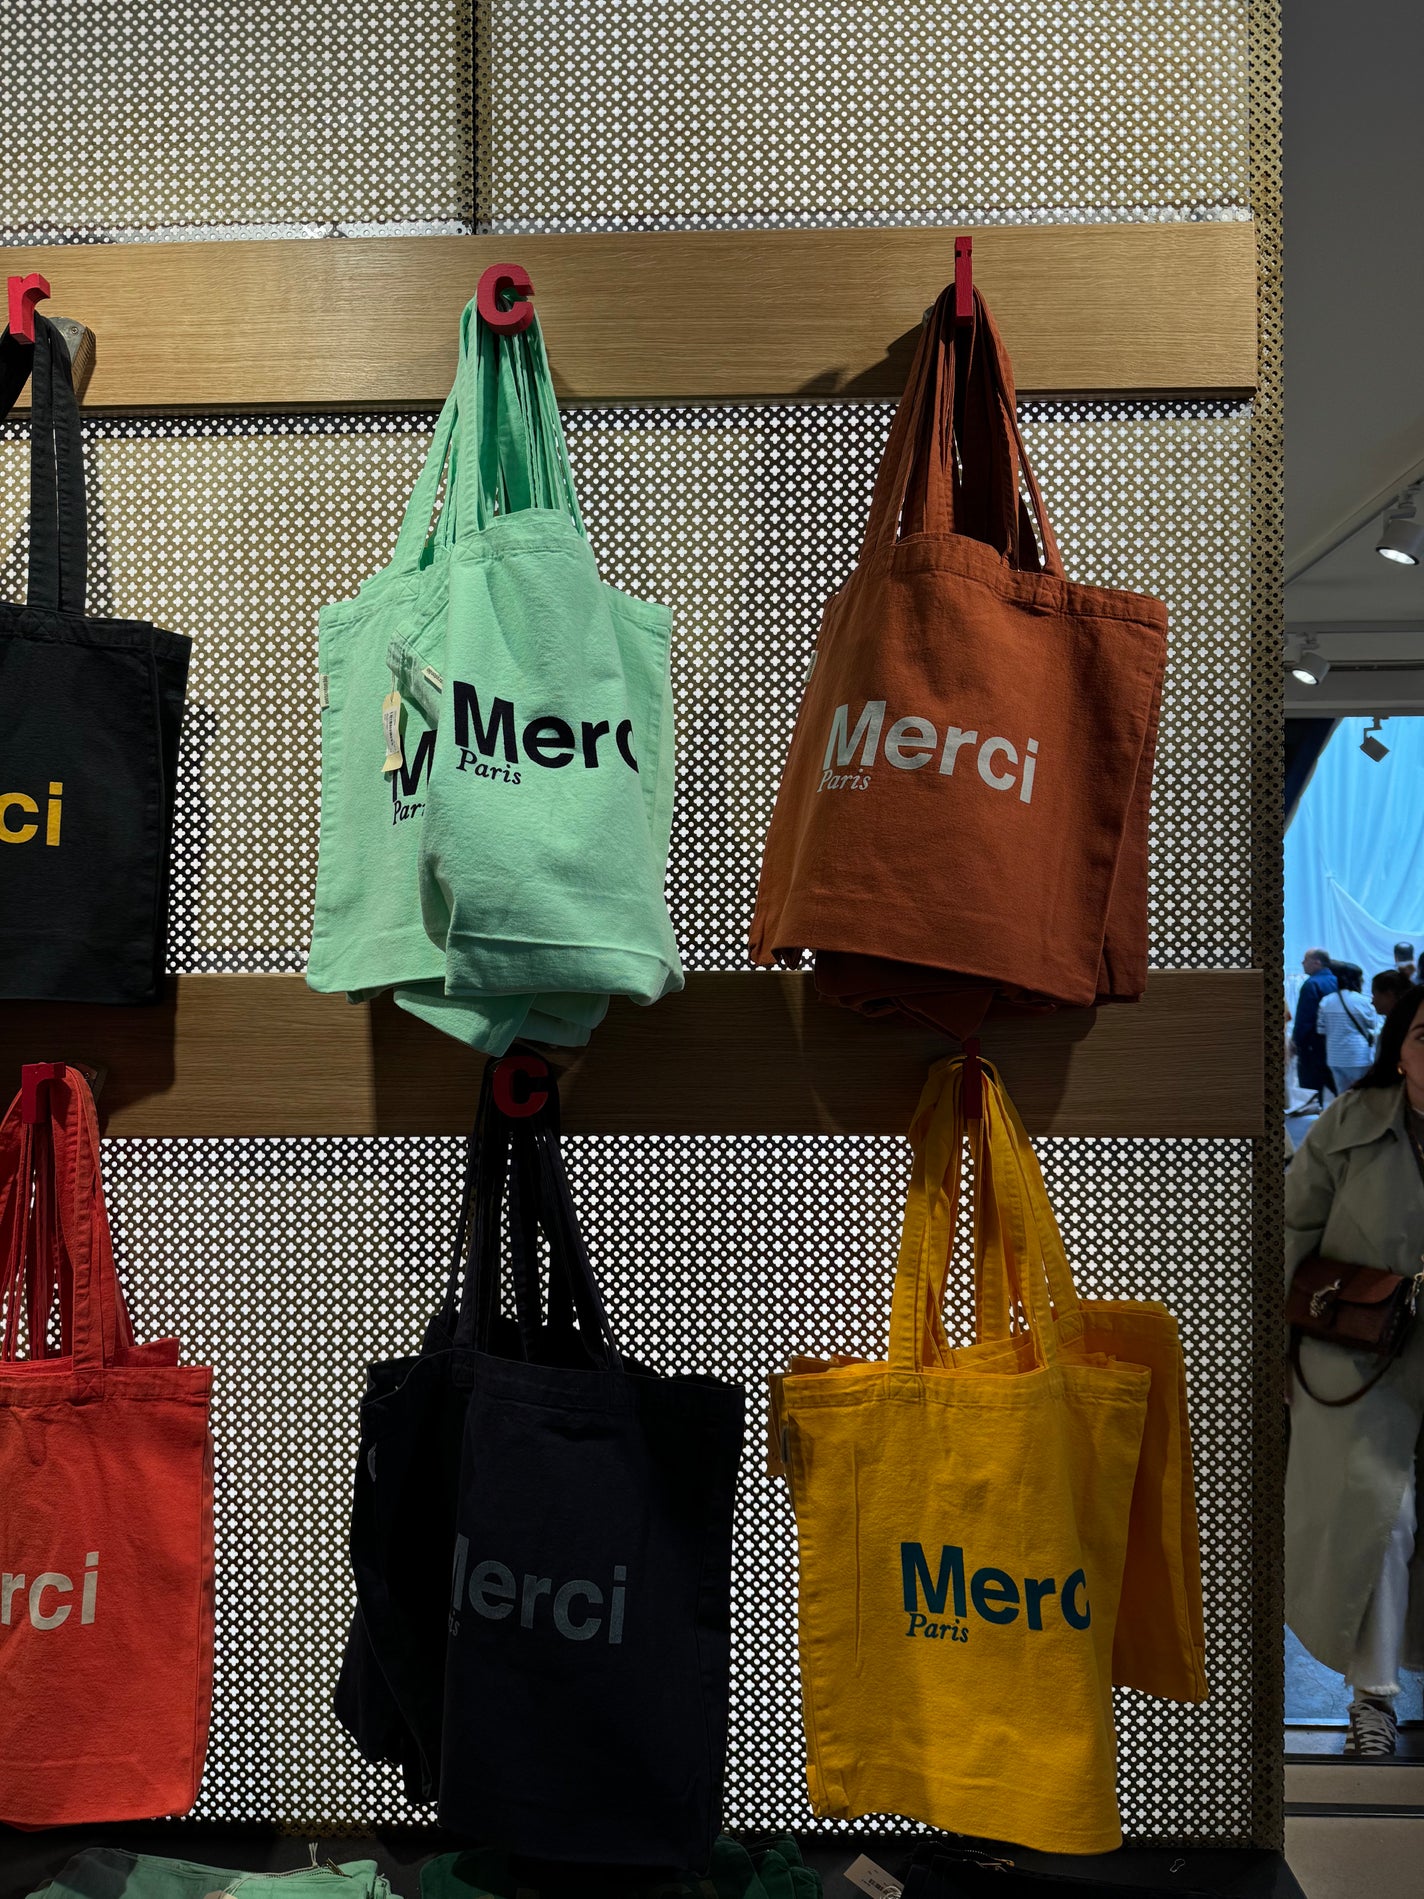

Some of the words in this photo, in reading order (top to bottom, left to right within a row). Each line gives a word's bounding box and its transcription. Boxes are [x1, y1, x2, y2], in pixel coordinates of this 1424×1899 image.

[7, 272, 51, 345] r
[455, 748, 522, 785] Paris
[816, 767, 872, 793] Paris
[822, 700, 1040, 804] Merci
[0, 781, 64, 847] ci
[0, 1551, 100, 1631] rci
[900, 1541, 1092, 1632] Merc
[904, 1612, 970, 1643] Paris
